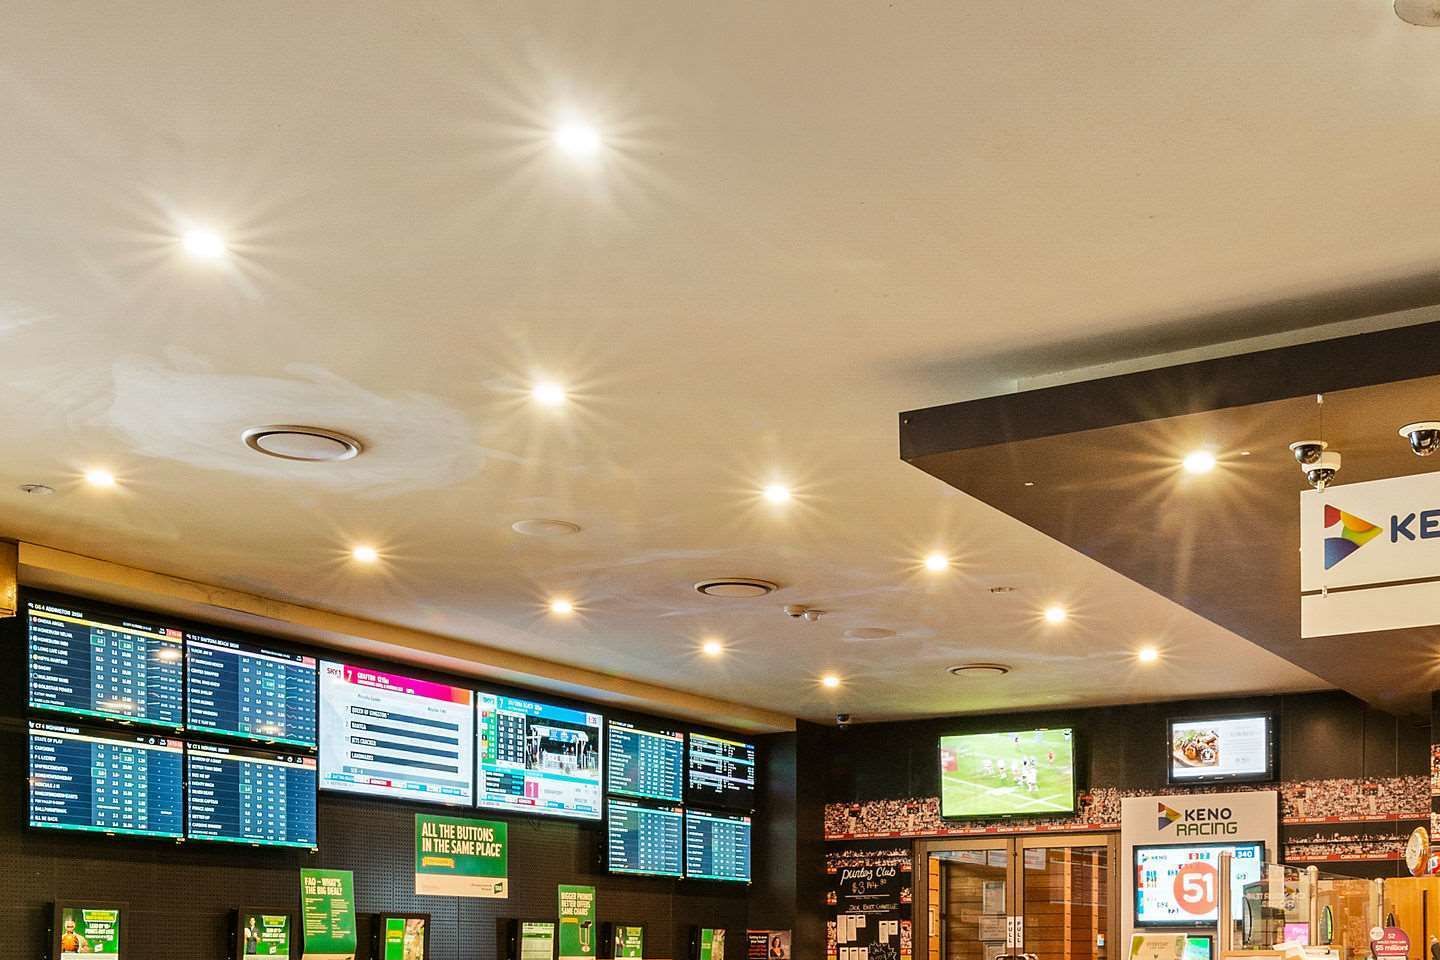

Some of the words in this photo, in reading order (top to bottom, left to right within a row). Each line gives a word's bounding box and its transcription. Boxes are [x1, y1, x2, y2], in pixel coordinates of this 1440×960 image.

[346, 670, 353, 682] 7
[1185, 808, 1232, 821] KENO
[422, 822, 438, 837] ALL
[438, 824, 455, 839] THE
[456, 825, 494, 842] BUTTONS
[1176, 822, 1238, 836] RACING
[422, 837, 432, 852] IN
[433, 839, 449, 853] THE
[450, 840, 474, 855] SAME
[876, 866, 896, 877] Club
[304, 877, 316, 887] FAQ
[1183, 872, 1214, 903] 51
[305, 886, 316, 895] THE
[317, 886, 326, 895] BIG
